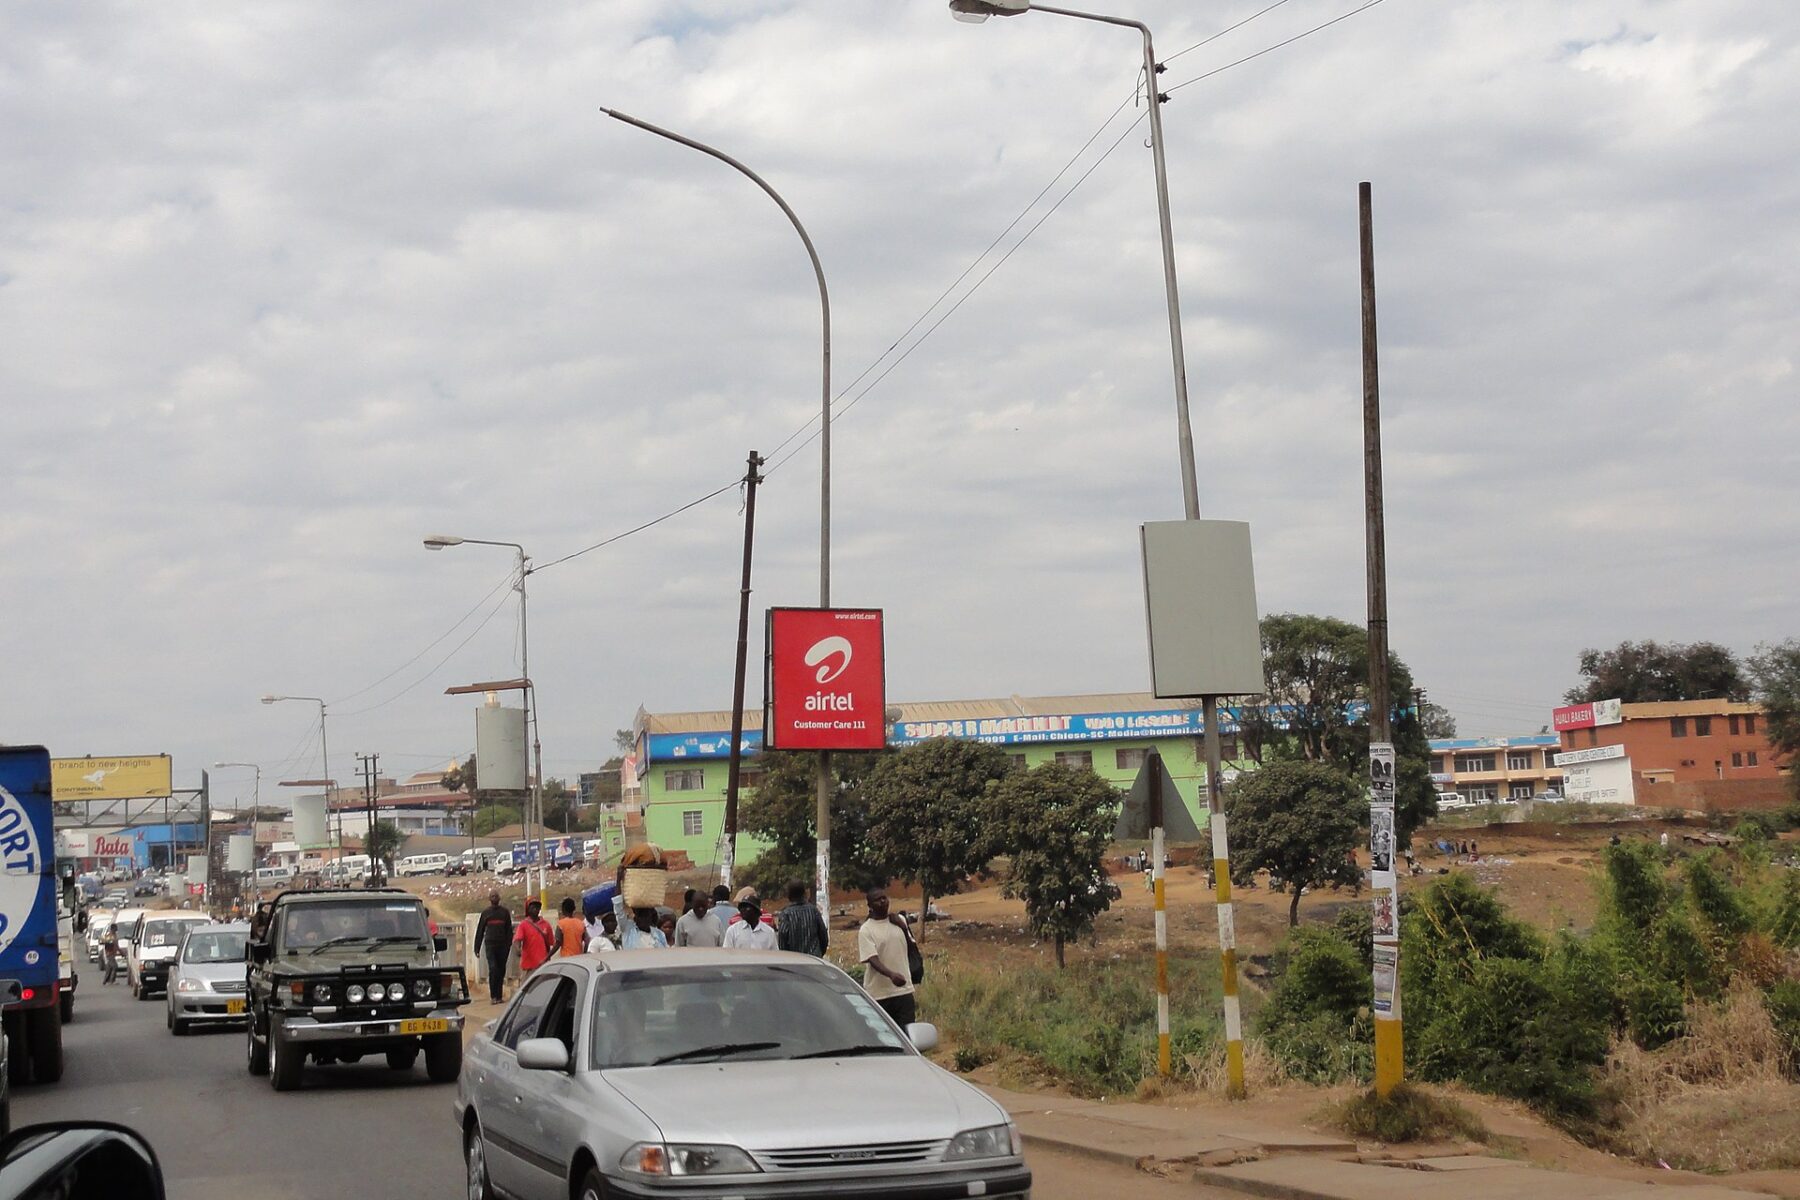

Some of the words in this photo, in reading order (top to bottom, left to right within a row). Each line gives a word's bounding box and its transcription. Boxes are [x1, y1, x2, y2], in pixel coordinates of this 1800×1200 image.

[805, 691, 854, 711] airtel
[1571, 710, 1592, 722] BAKERY
[794, 720, 832, 729] Customer
[833, 720, 852, 729] Care
[853, 721, 866, 729] 111
[59, 761, 84, 769] brand
[87, 760, 96, 768] to
[119, 759, 152, 769] heights
[95, 836, 130, 855] Bata
